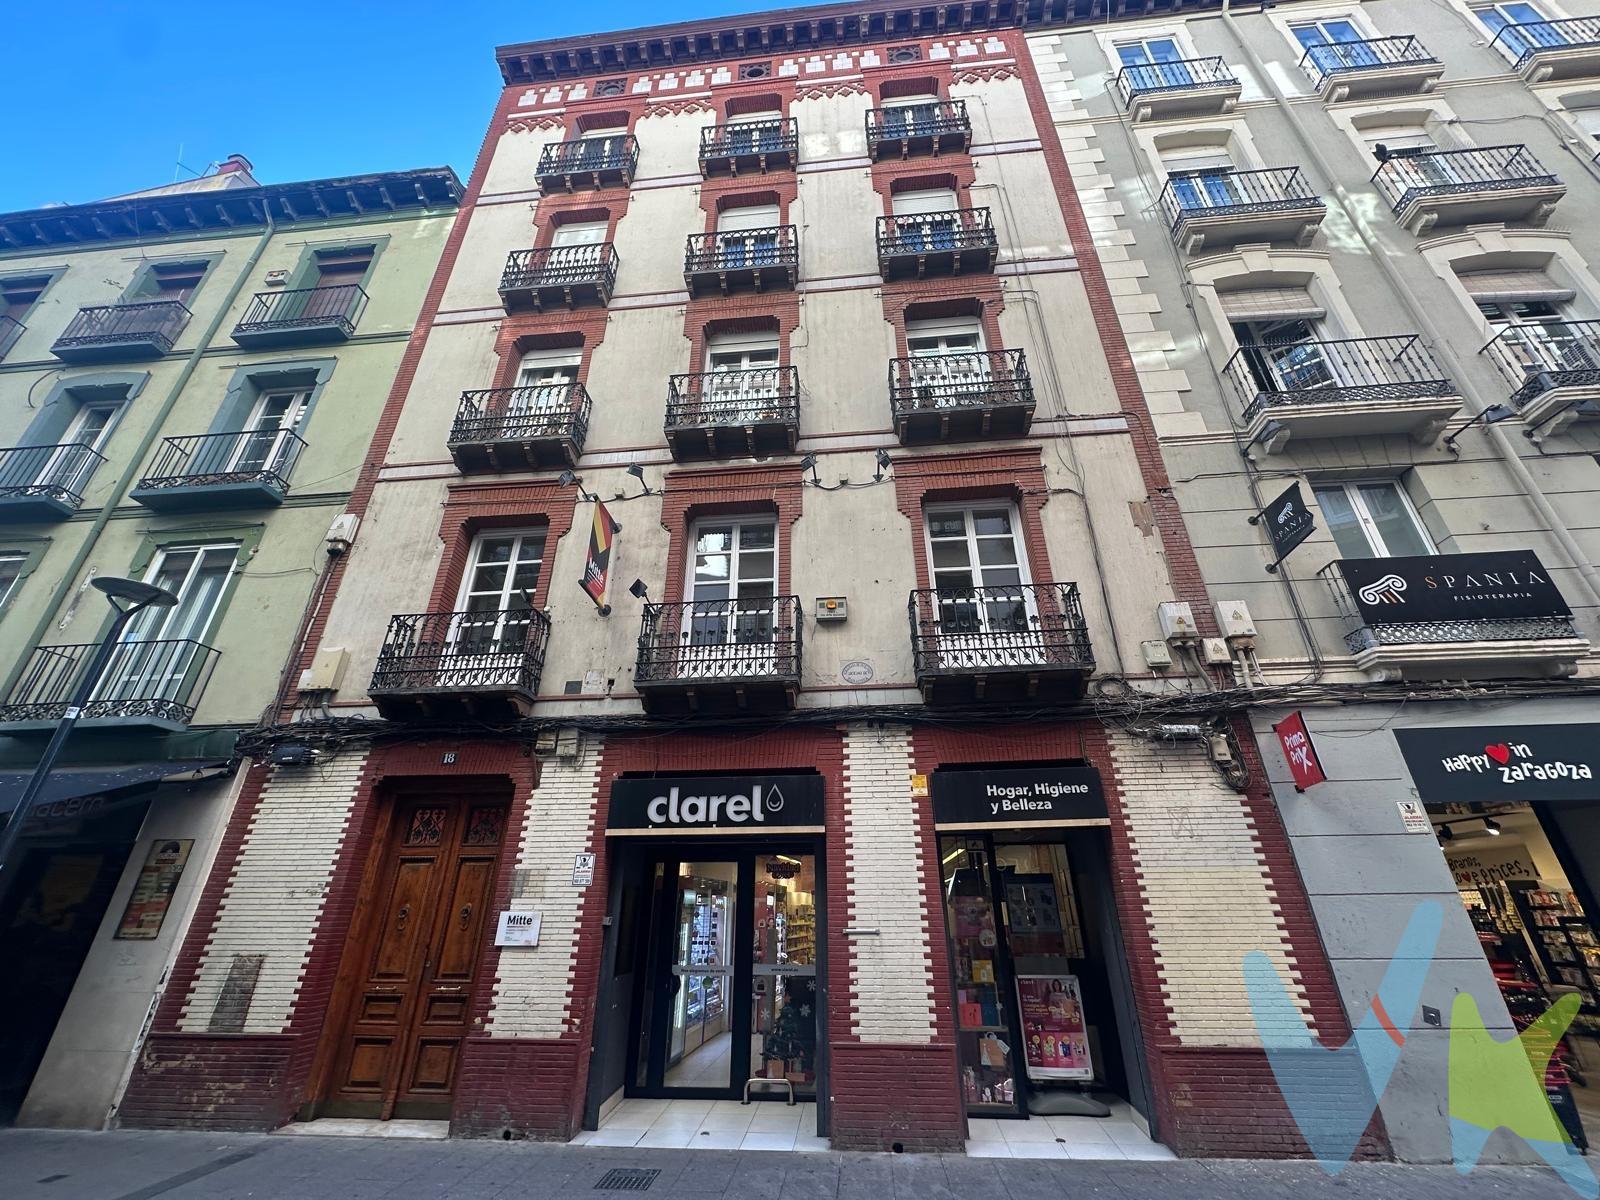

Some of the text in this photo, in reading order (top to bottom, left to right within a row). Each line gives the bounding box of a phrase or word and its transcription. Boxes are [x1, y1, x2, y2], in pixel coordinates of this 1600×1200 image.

[588, 557, 604, 583] Mitte
[1424, 571, 1545, 589] SPANIA
[1453, 592, 1532, 601] FISIOTERAPIA
[1284, 731, 1305, 750] Prima
[443, 753, 455, 764] 18
[1441, 742, 1533, 773] Happy in
[986, 782, 1089, 799] Hogar, Higiene
[647, 785, 764, 823] clarel
[990, 799, 1052, 814] y Belleza
[507, 915, 532, 926] Mitte
